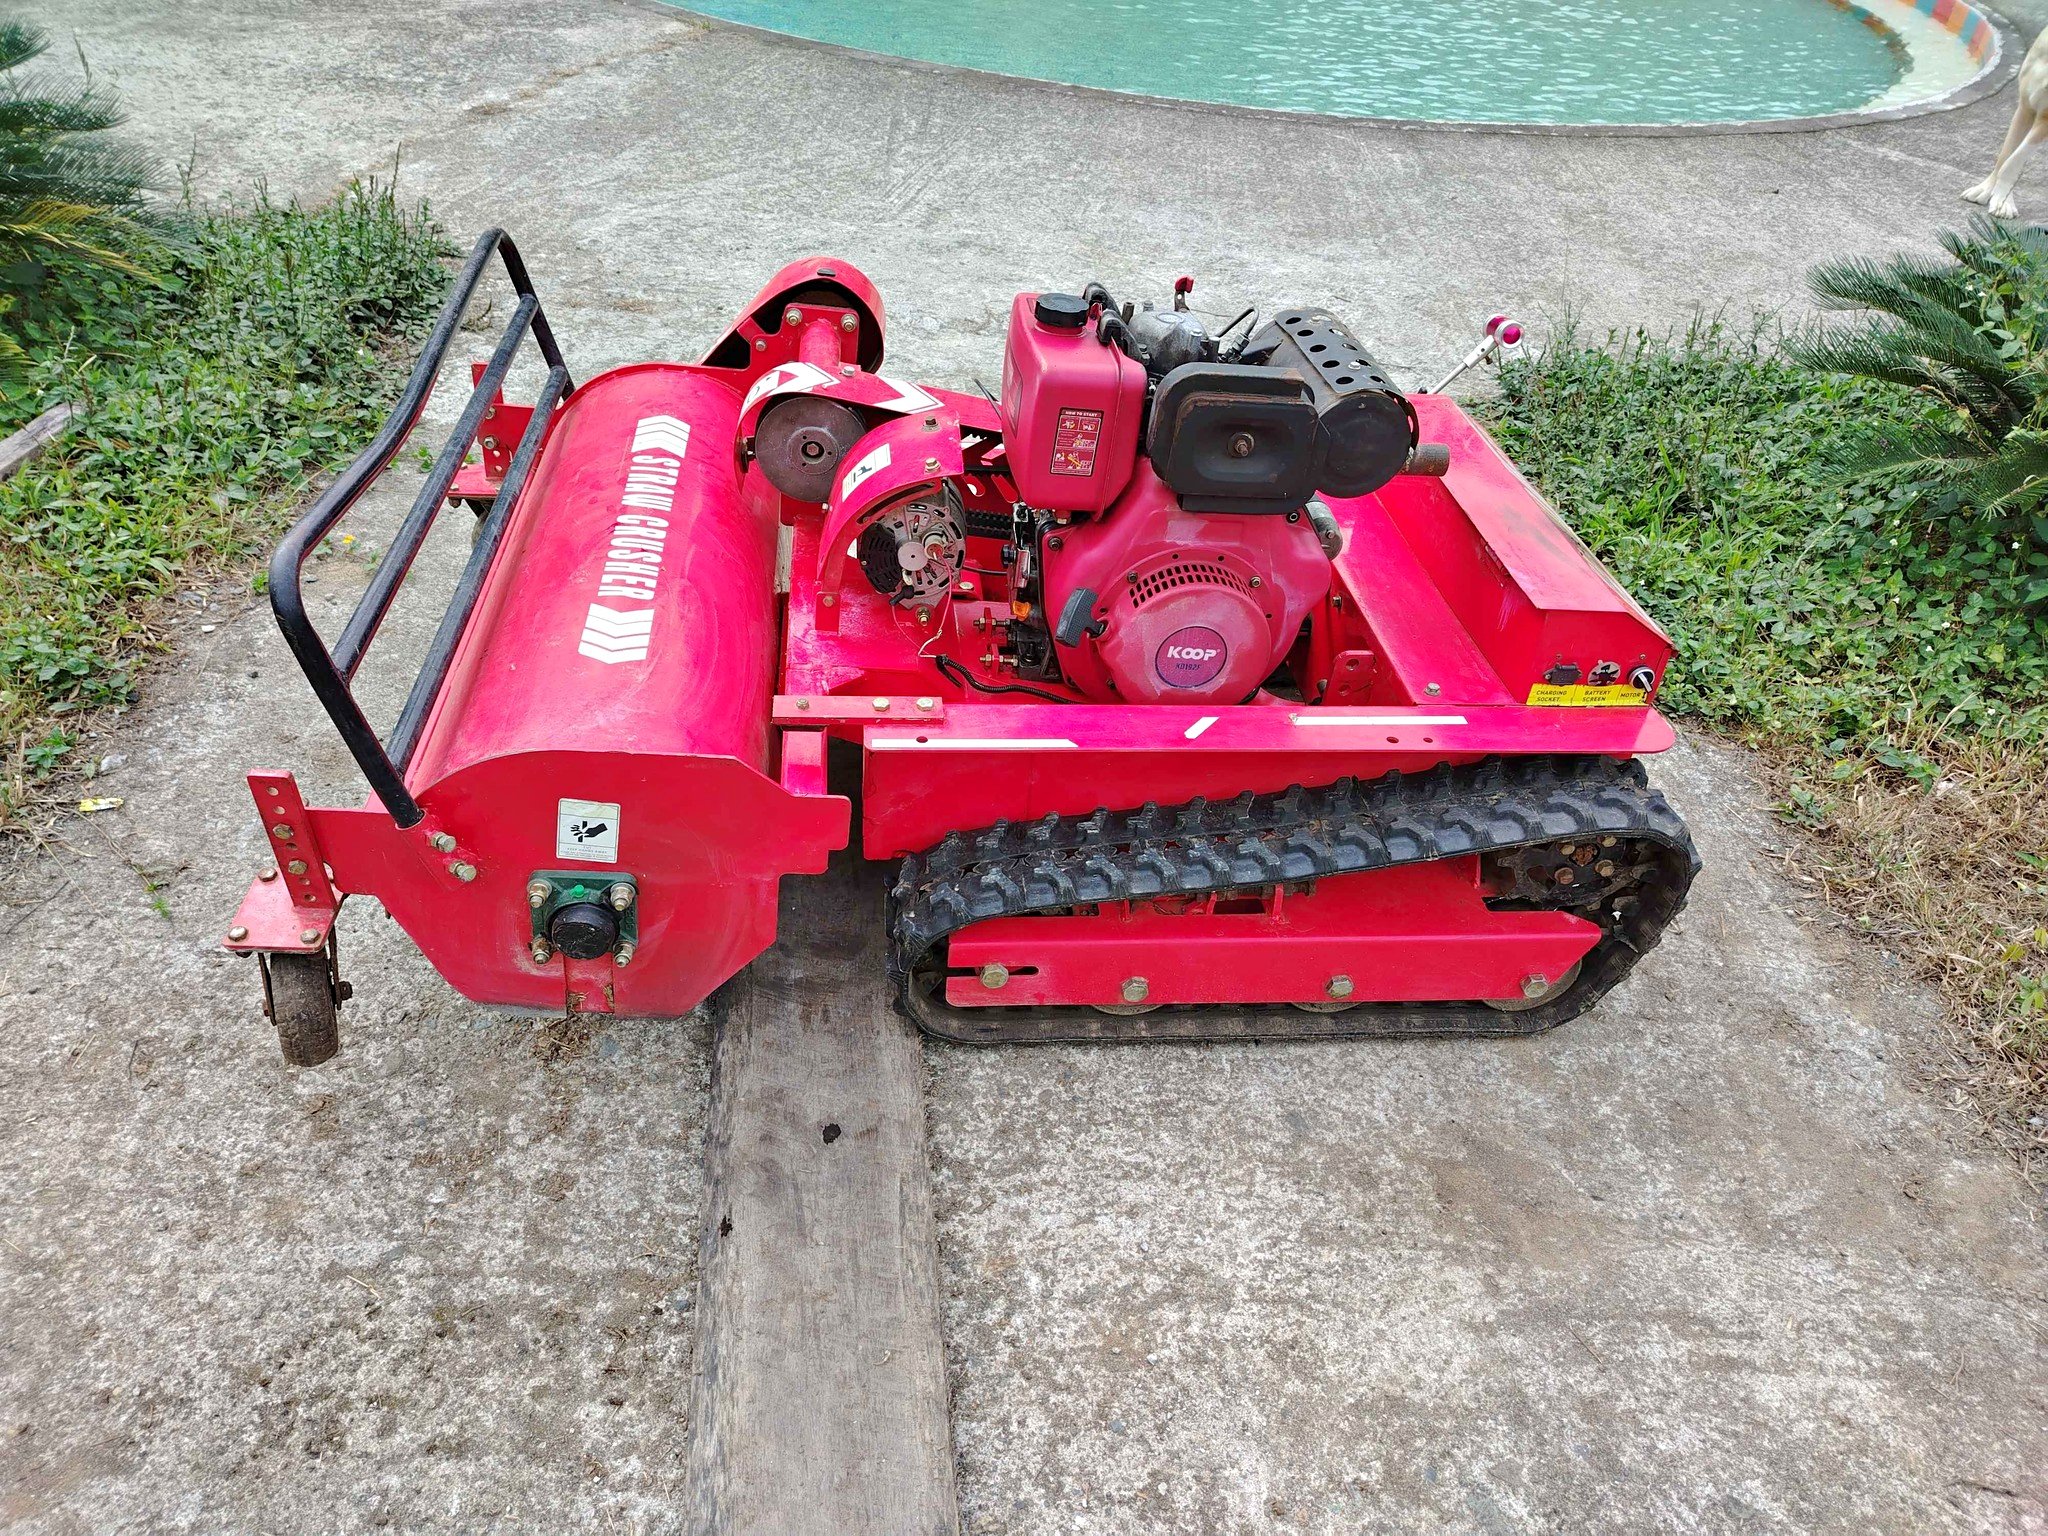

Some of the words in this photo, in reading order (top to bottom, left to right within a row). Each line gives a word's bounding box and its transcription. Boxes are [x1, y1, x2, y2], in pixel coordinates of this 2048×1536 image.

[621, 455, 681, 512] STRAW
[597, 514, 669, 601] CRUSHER
[1167, 646, 1217, 661] KOOP
